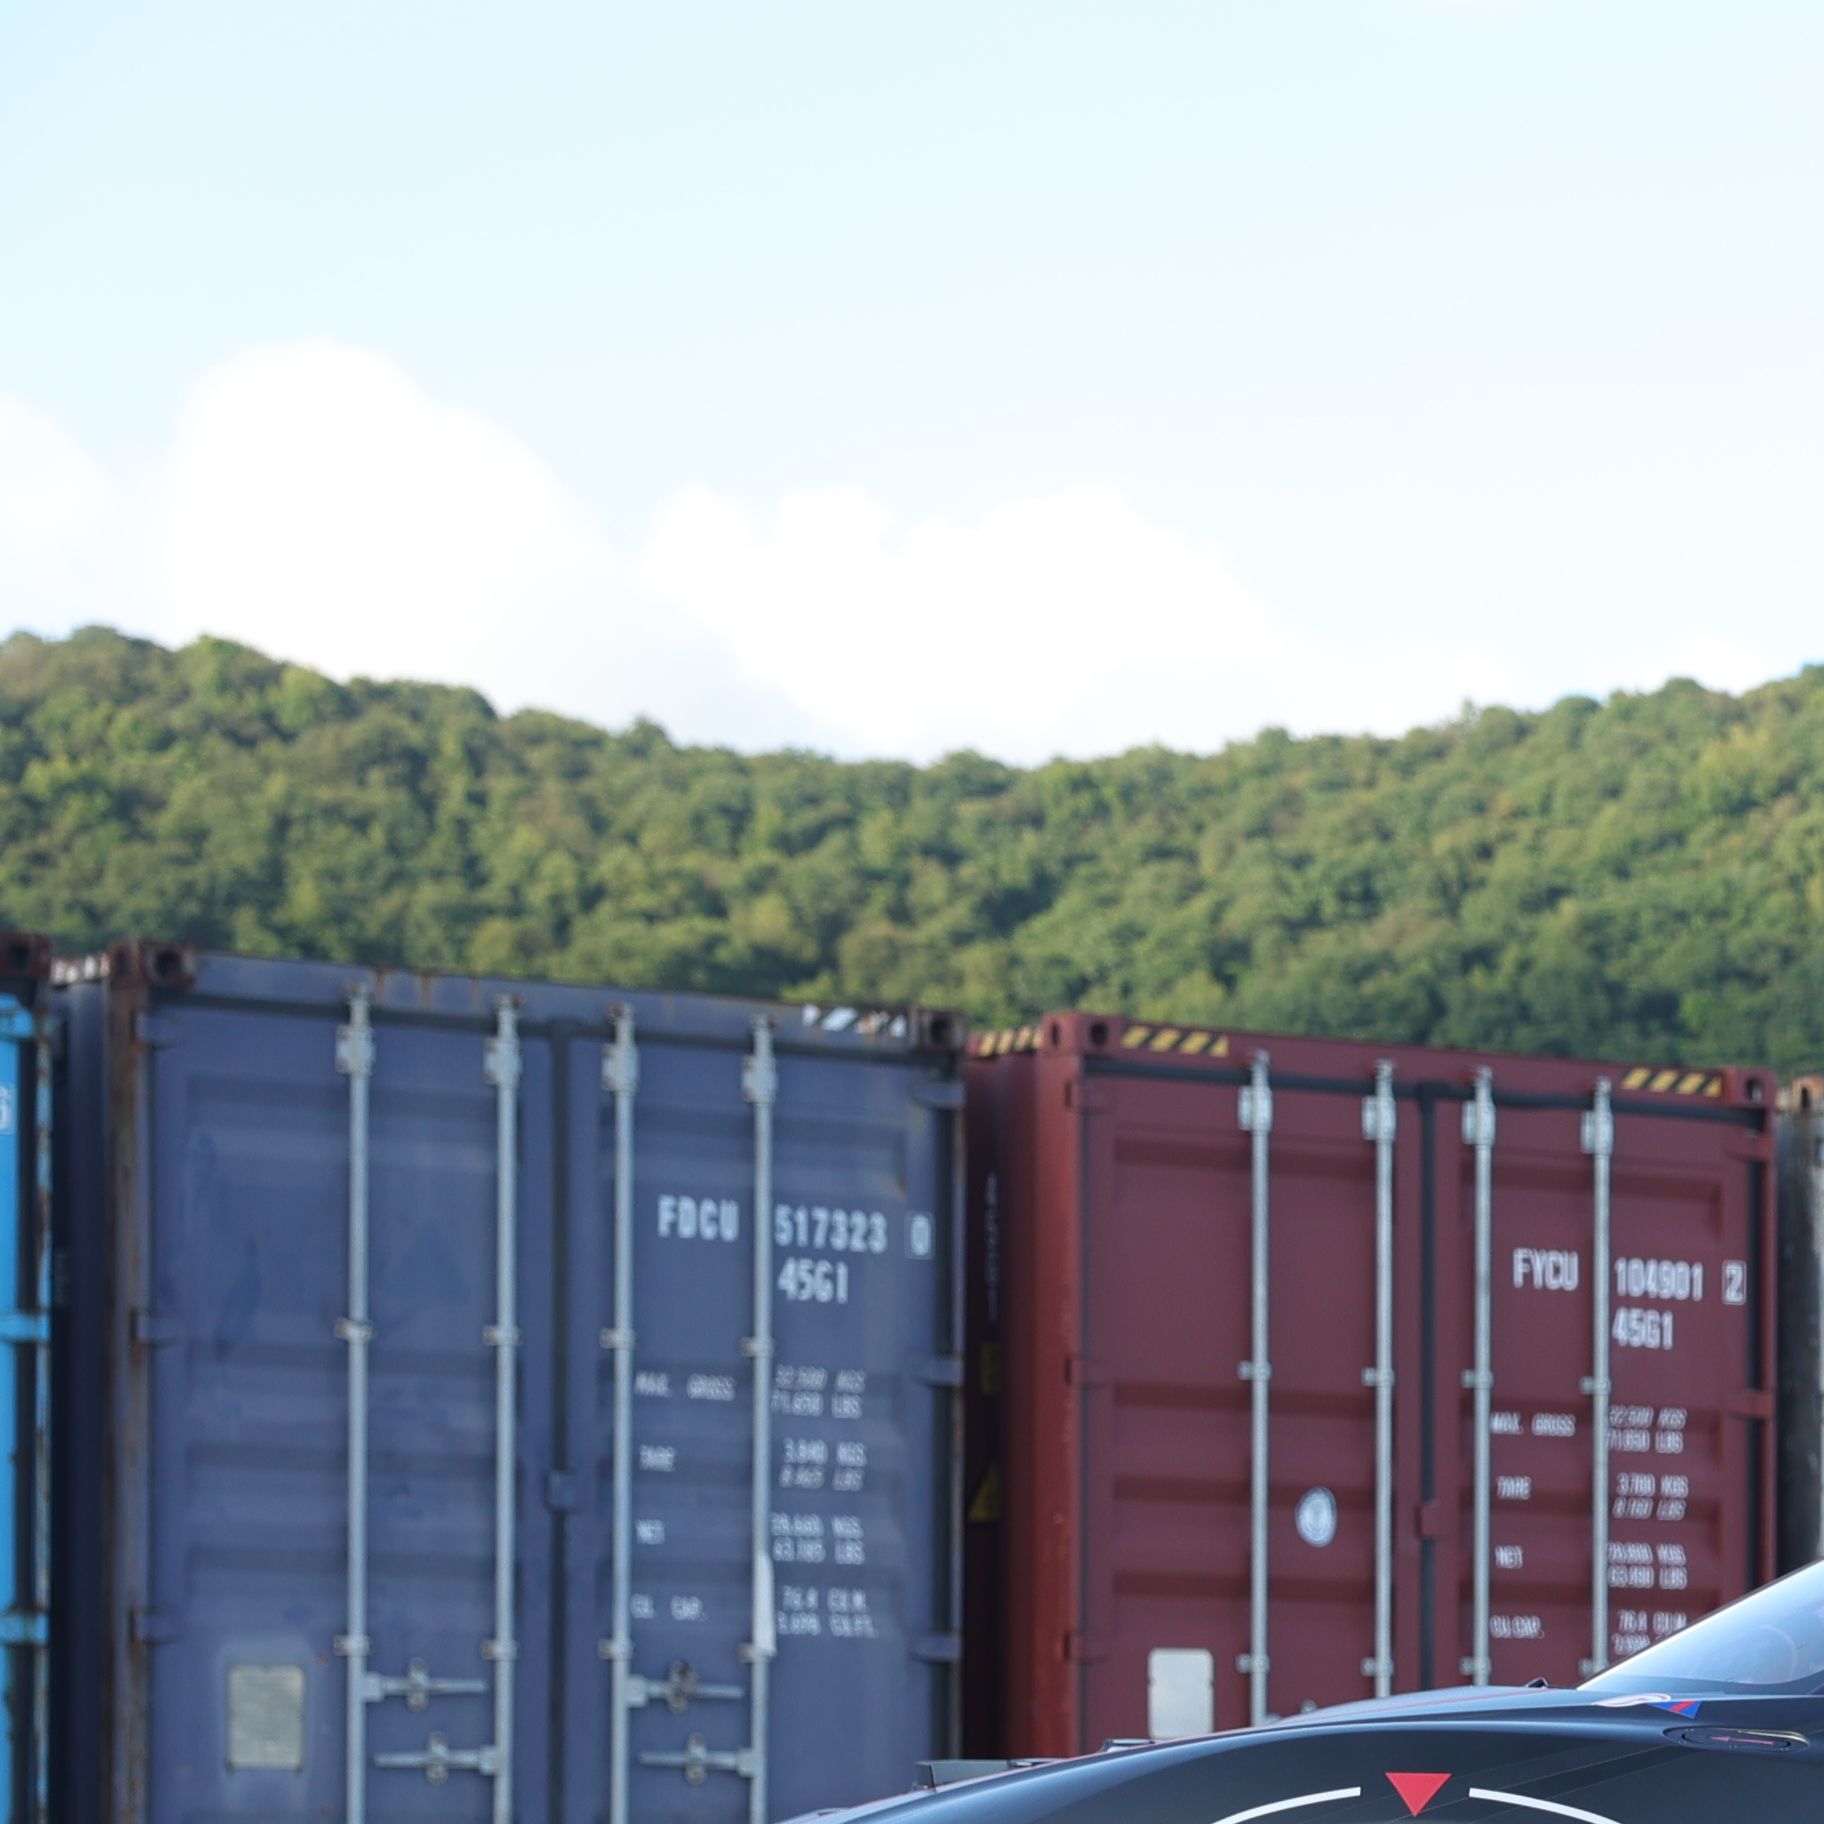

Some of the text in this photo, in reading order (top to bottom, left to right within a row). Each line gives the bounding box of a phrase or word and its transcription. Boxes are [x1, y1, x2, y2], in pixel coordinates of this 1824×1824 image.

[657, 1195, 738, 1242] FDCU
[775, 1204, 887, 1254] 517323
[778, 1257, 849, 1303] 45G1
[1513, 1247, 1744, 1303] FYCU 104901 2
[1612, 1307, 1673, 1350] 45G1
